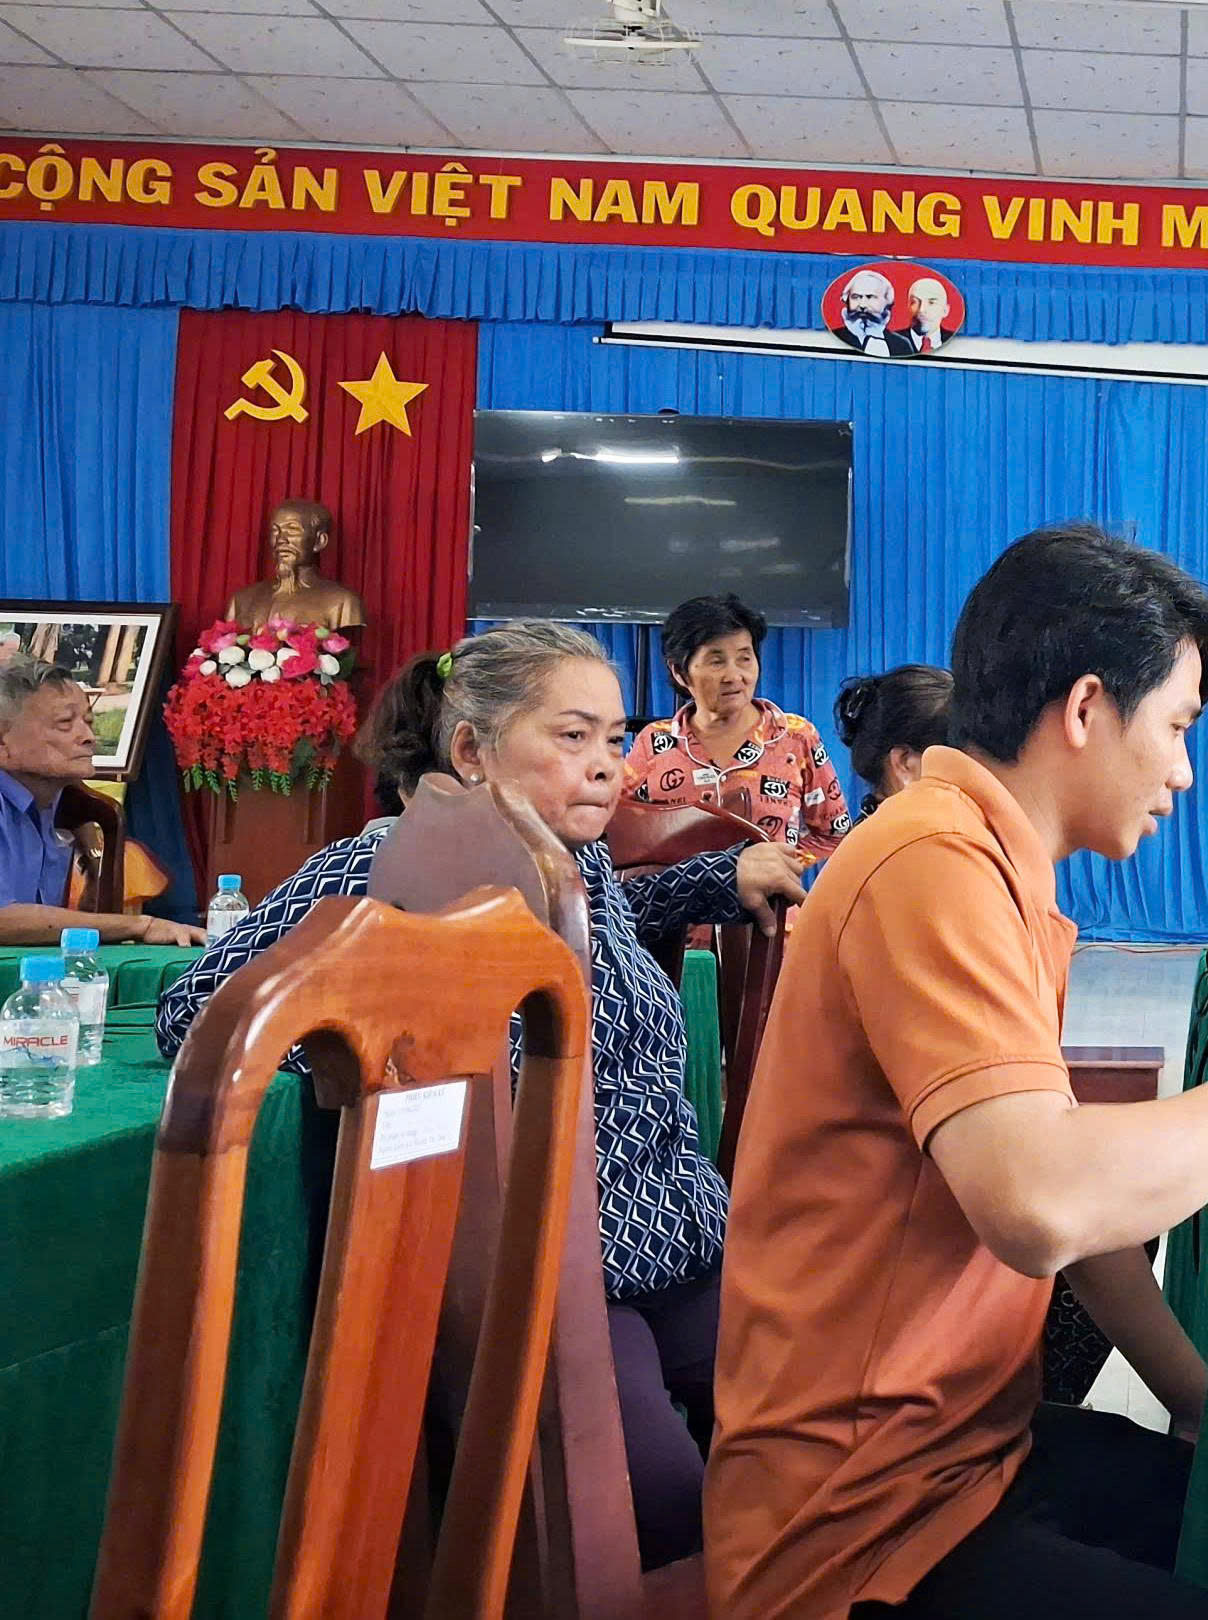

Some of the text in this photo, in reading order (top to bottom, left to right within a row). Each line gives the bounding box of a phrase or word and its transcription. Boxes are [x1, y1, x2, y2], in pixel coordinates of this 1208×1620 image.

[196, 148, 336, 210] SẢN
[365, 163, 521, 226] VIỆT
[550, 178, 698, 224] NAM
[731, 185, 960, 237] QUANG
[984, 196, 1139, 245] VINH
[4, 1035, 68, 1046] MIRACLE
